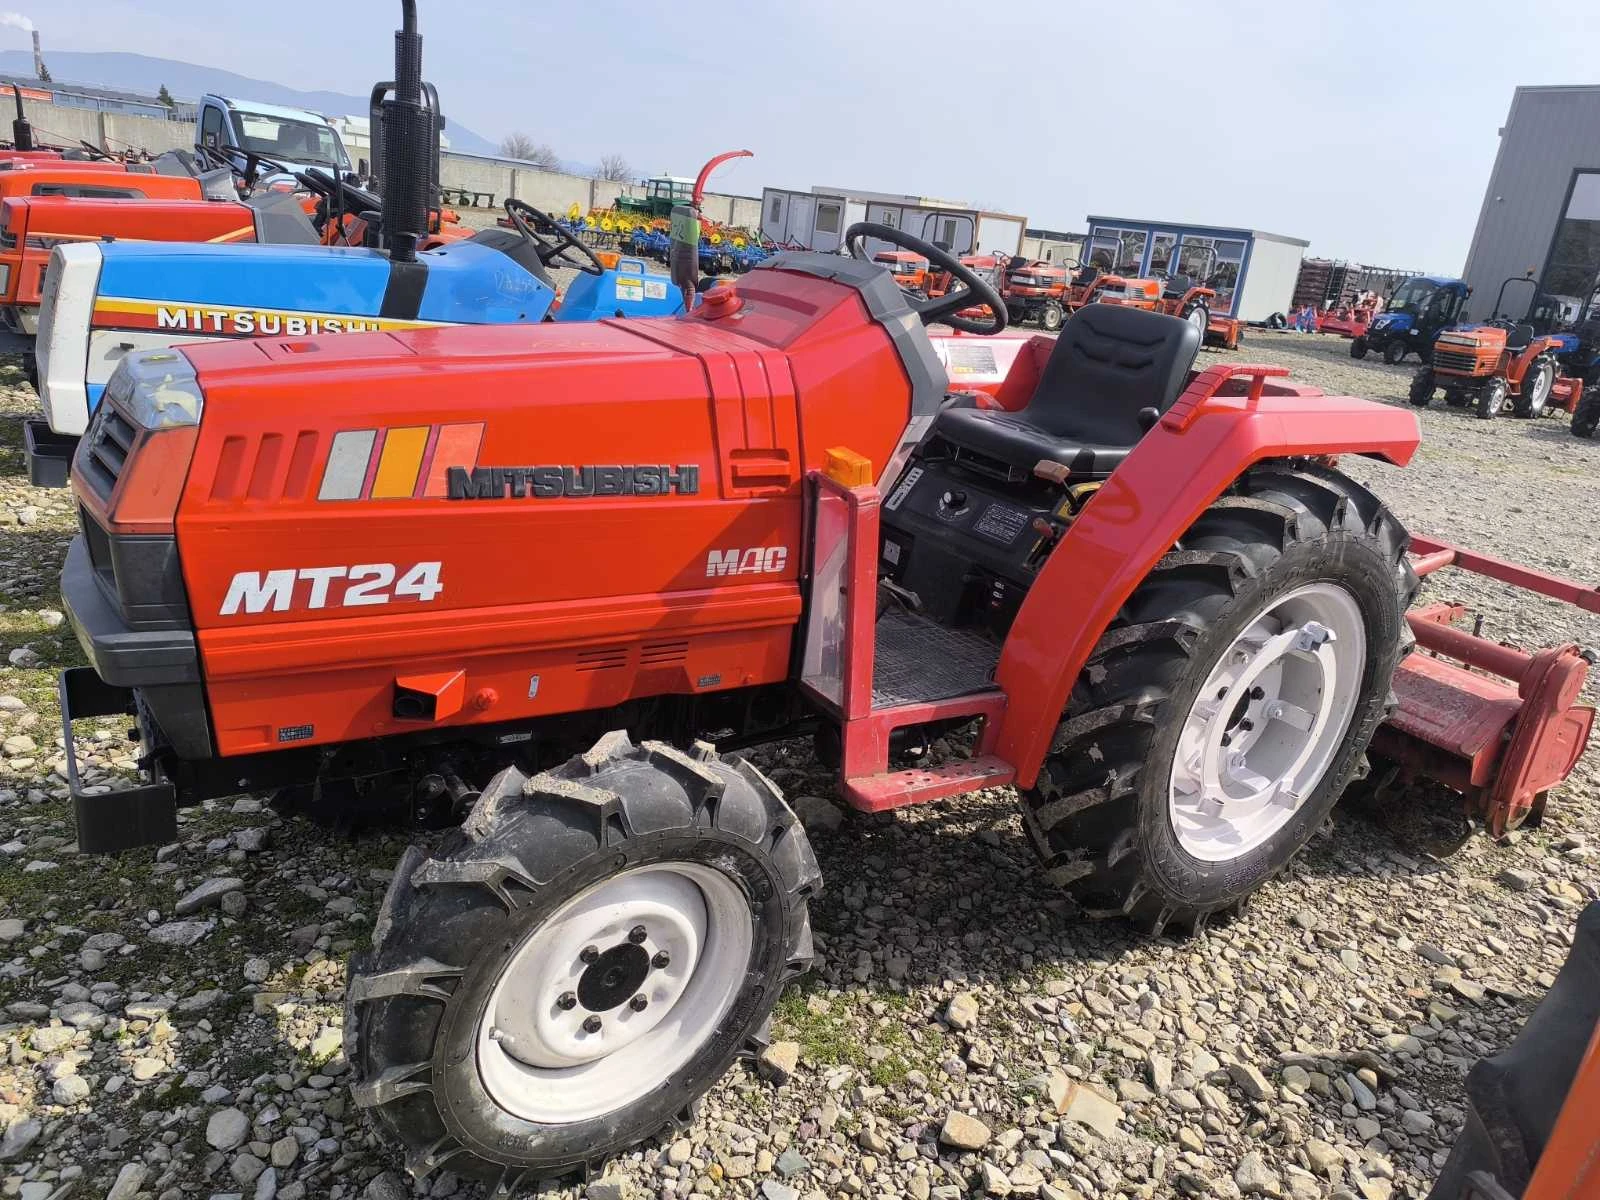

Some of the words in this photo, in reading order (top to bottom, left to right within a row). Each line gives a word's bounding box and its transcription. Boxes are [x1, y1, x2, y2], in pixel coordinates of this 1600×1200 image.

[447, 464, 699, 499] MITSUBISHI
[706, 546, 787, 577] MAC
[218, 561, 443, 616] MT24
